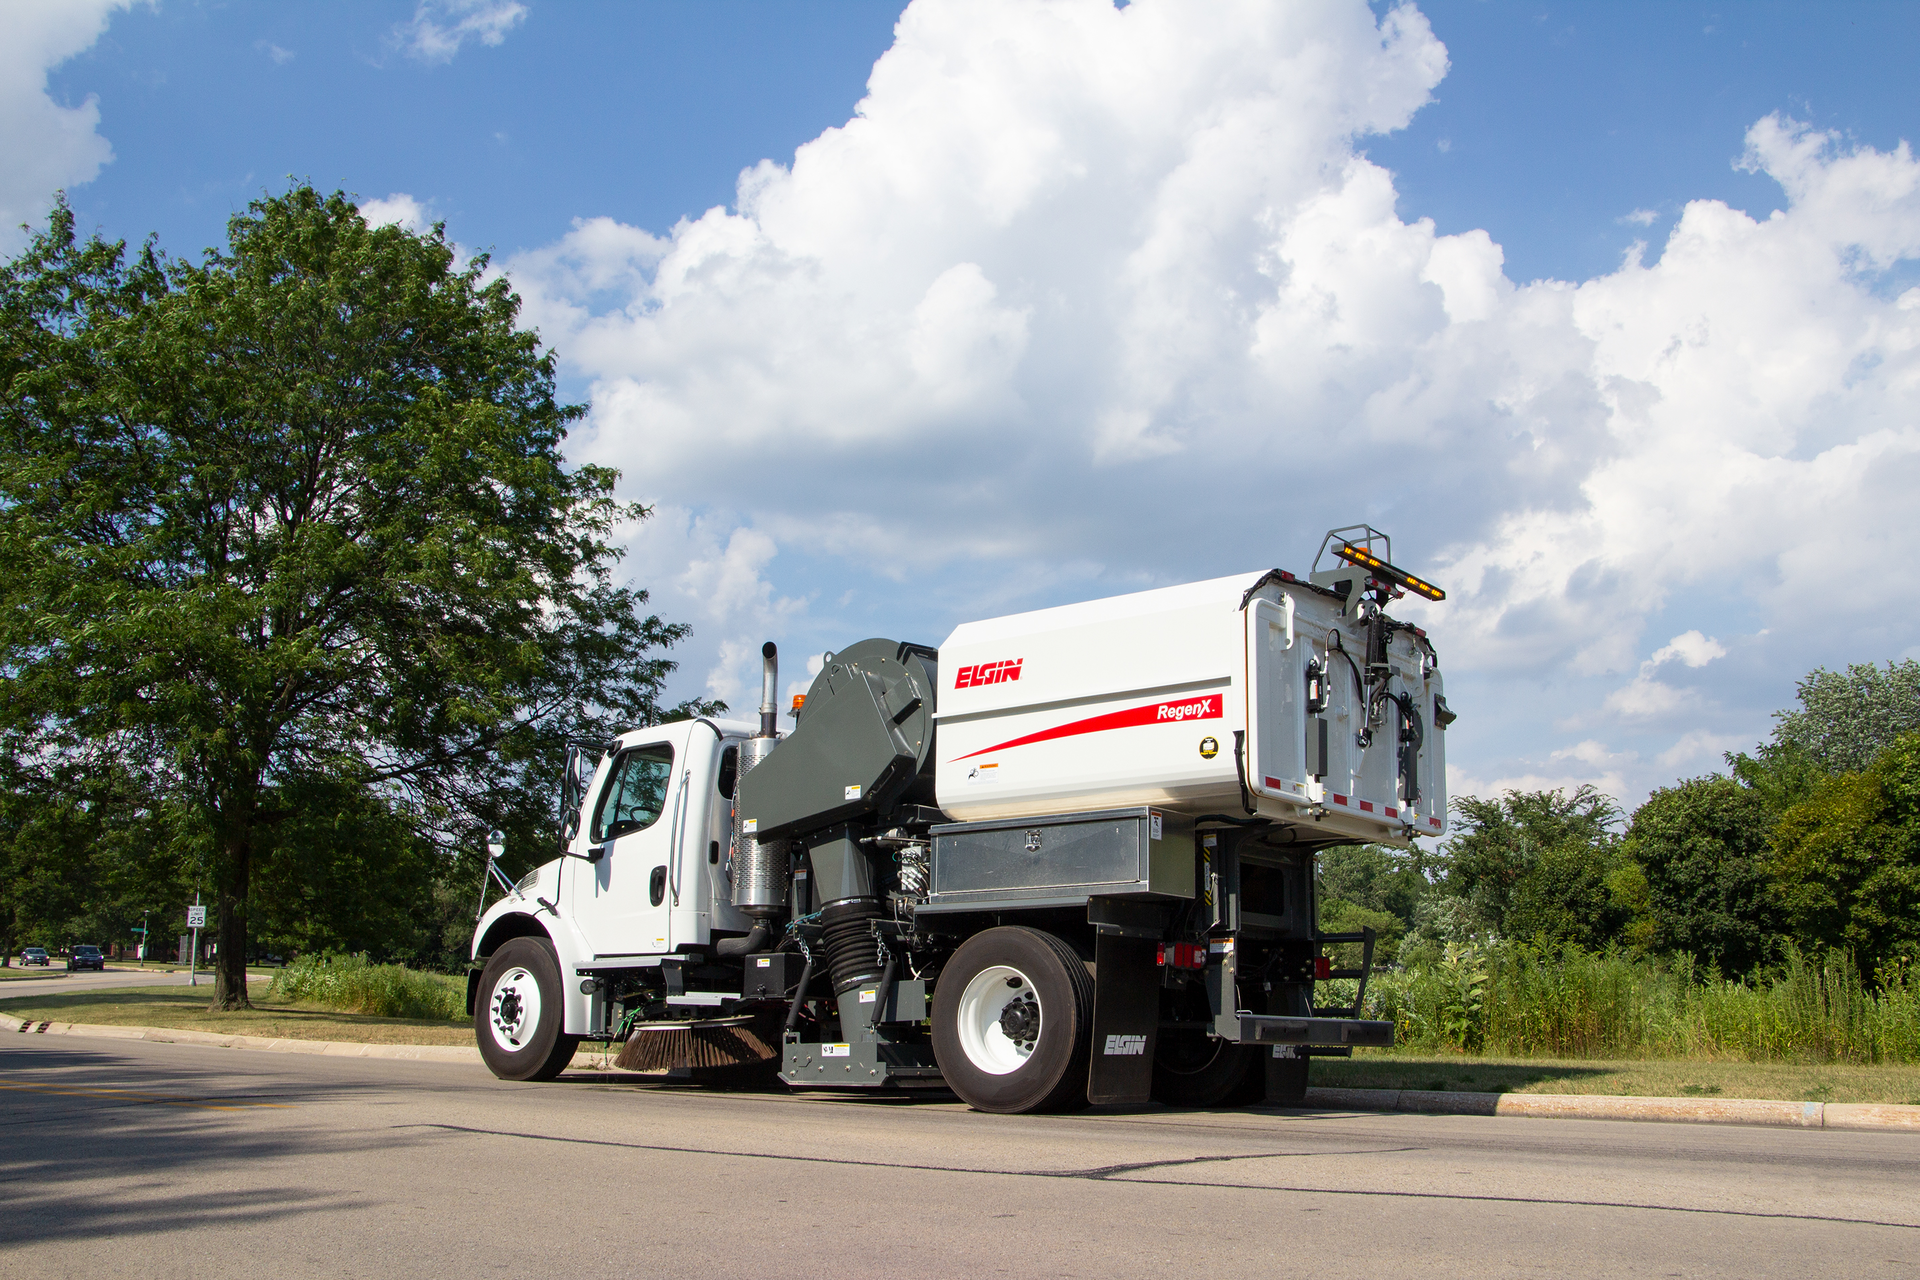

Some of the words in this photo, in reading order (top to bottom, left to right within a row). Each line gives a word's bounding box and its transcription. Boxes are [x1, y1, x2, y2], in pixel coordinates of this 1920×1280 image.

[954, 657, 1024, 690] ELGIN
[1157, 699, 1212, 720] RegenX
[190, 916, 204, 924] 25
[1103, 1034, 1147, 1055] ELGIN
